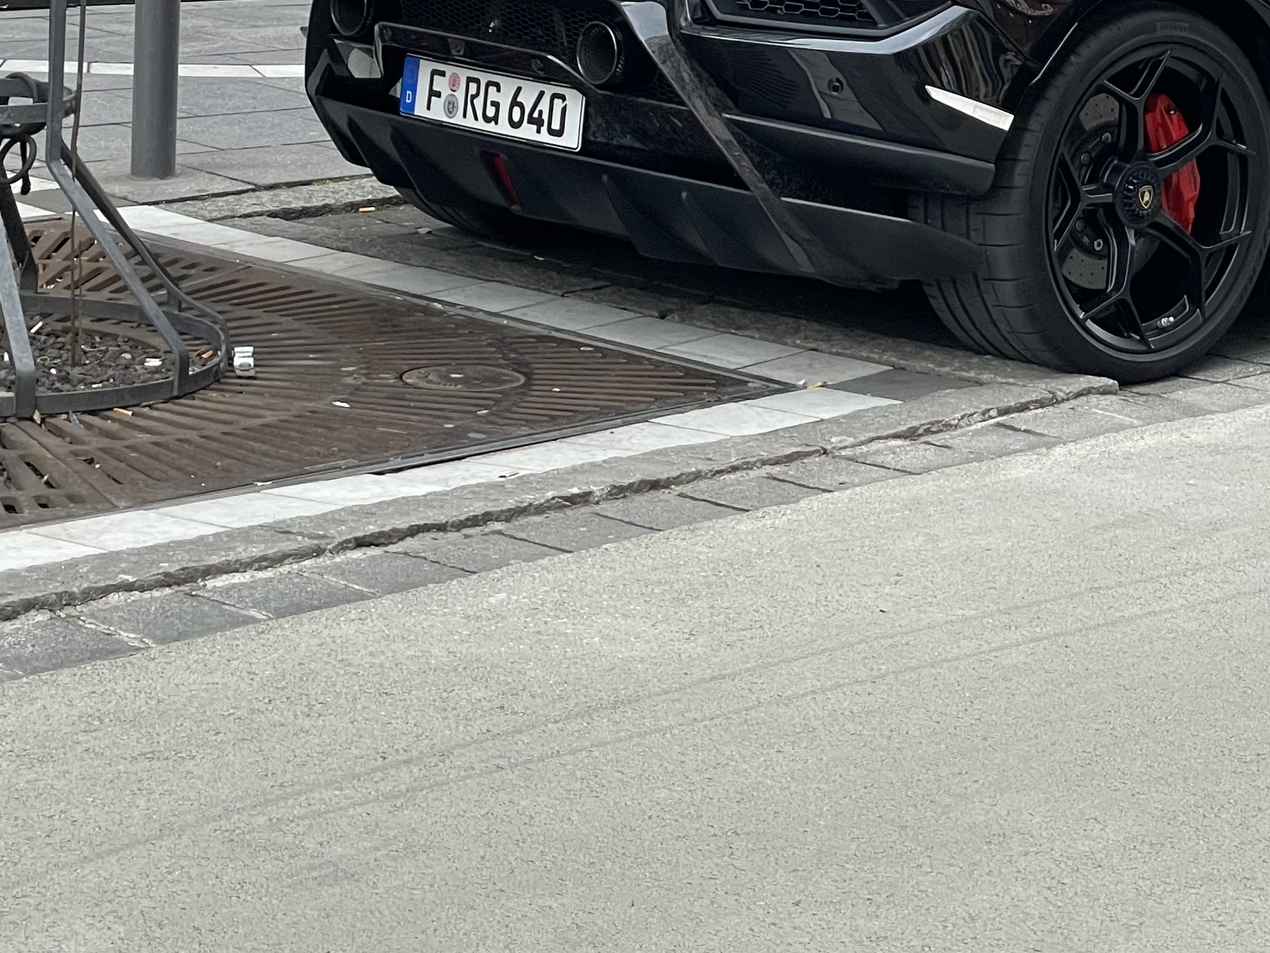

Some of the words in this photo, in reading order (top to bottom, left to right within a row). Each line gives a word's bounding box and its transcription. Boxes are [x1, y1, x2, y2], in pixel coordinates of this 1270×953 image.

[405, 90, 412, 103] D
[426, 68, 446, 111] F
[462, 76, 502, 126] RG
[507, 85, 568, 138] 640
